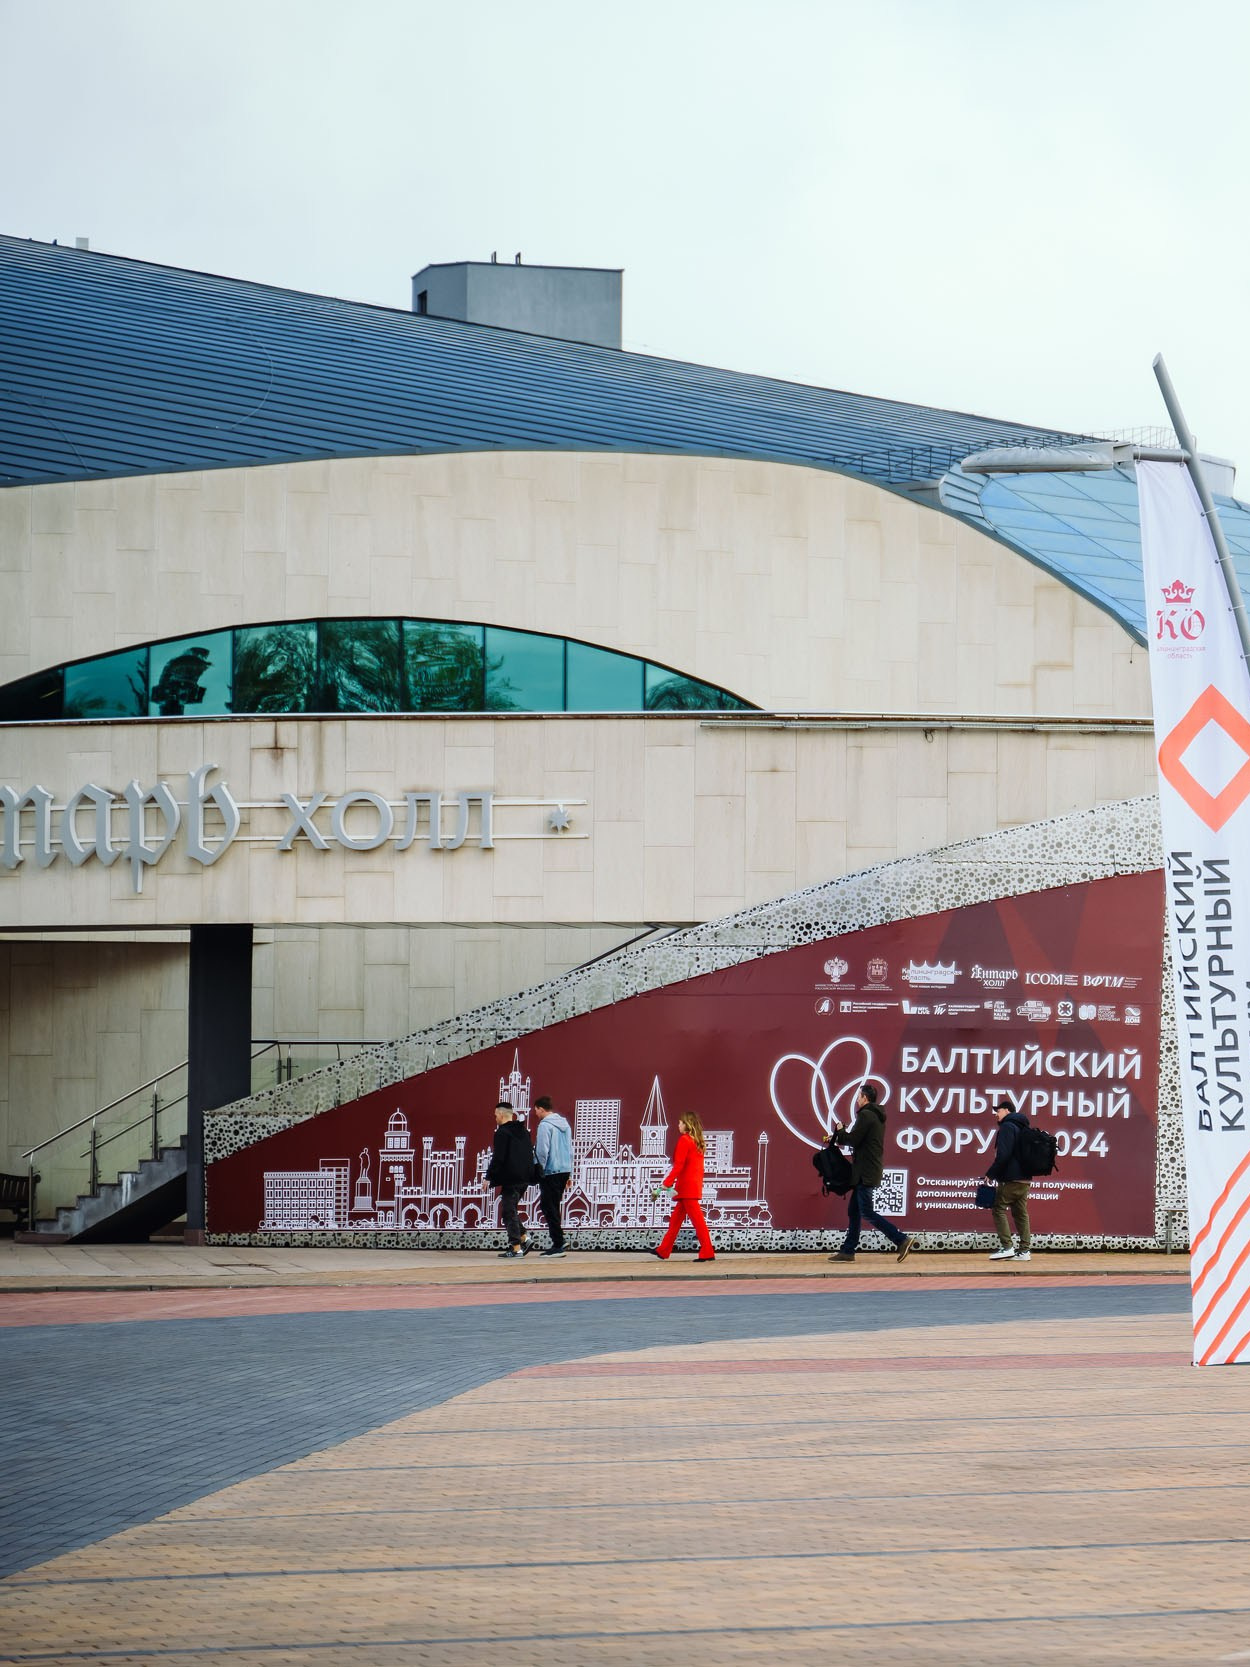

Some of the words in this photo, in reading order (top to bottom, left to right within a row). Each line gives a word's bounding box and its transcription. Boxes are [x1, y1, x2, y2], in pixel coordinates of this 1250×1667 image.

[1024, 972, 1063, 986] ICOM
[1166, 851, 1214, 1132] БАЛТИЙСКИЙ
[1196, 859, 1246, 1132] КУЛЬТУРНЫЙ
[901, 1044, 1142, 1080] БАЛТИЙСКИЙ
[899, 1086, 1131, 1119] КУЛЬТУРНЫЙ
[896, 1127, 998, 1154] ФОРУ
[1054, 1131, 1109, 1157] 024
[1042, 1181, 1094, 1192] получения
